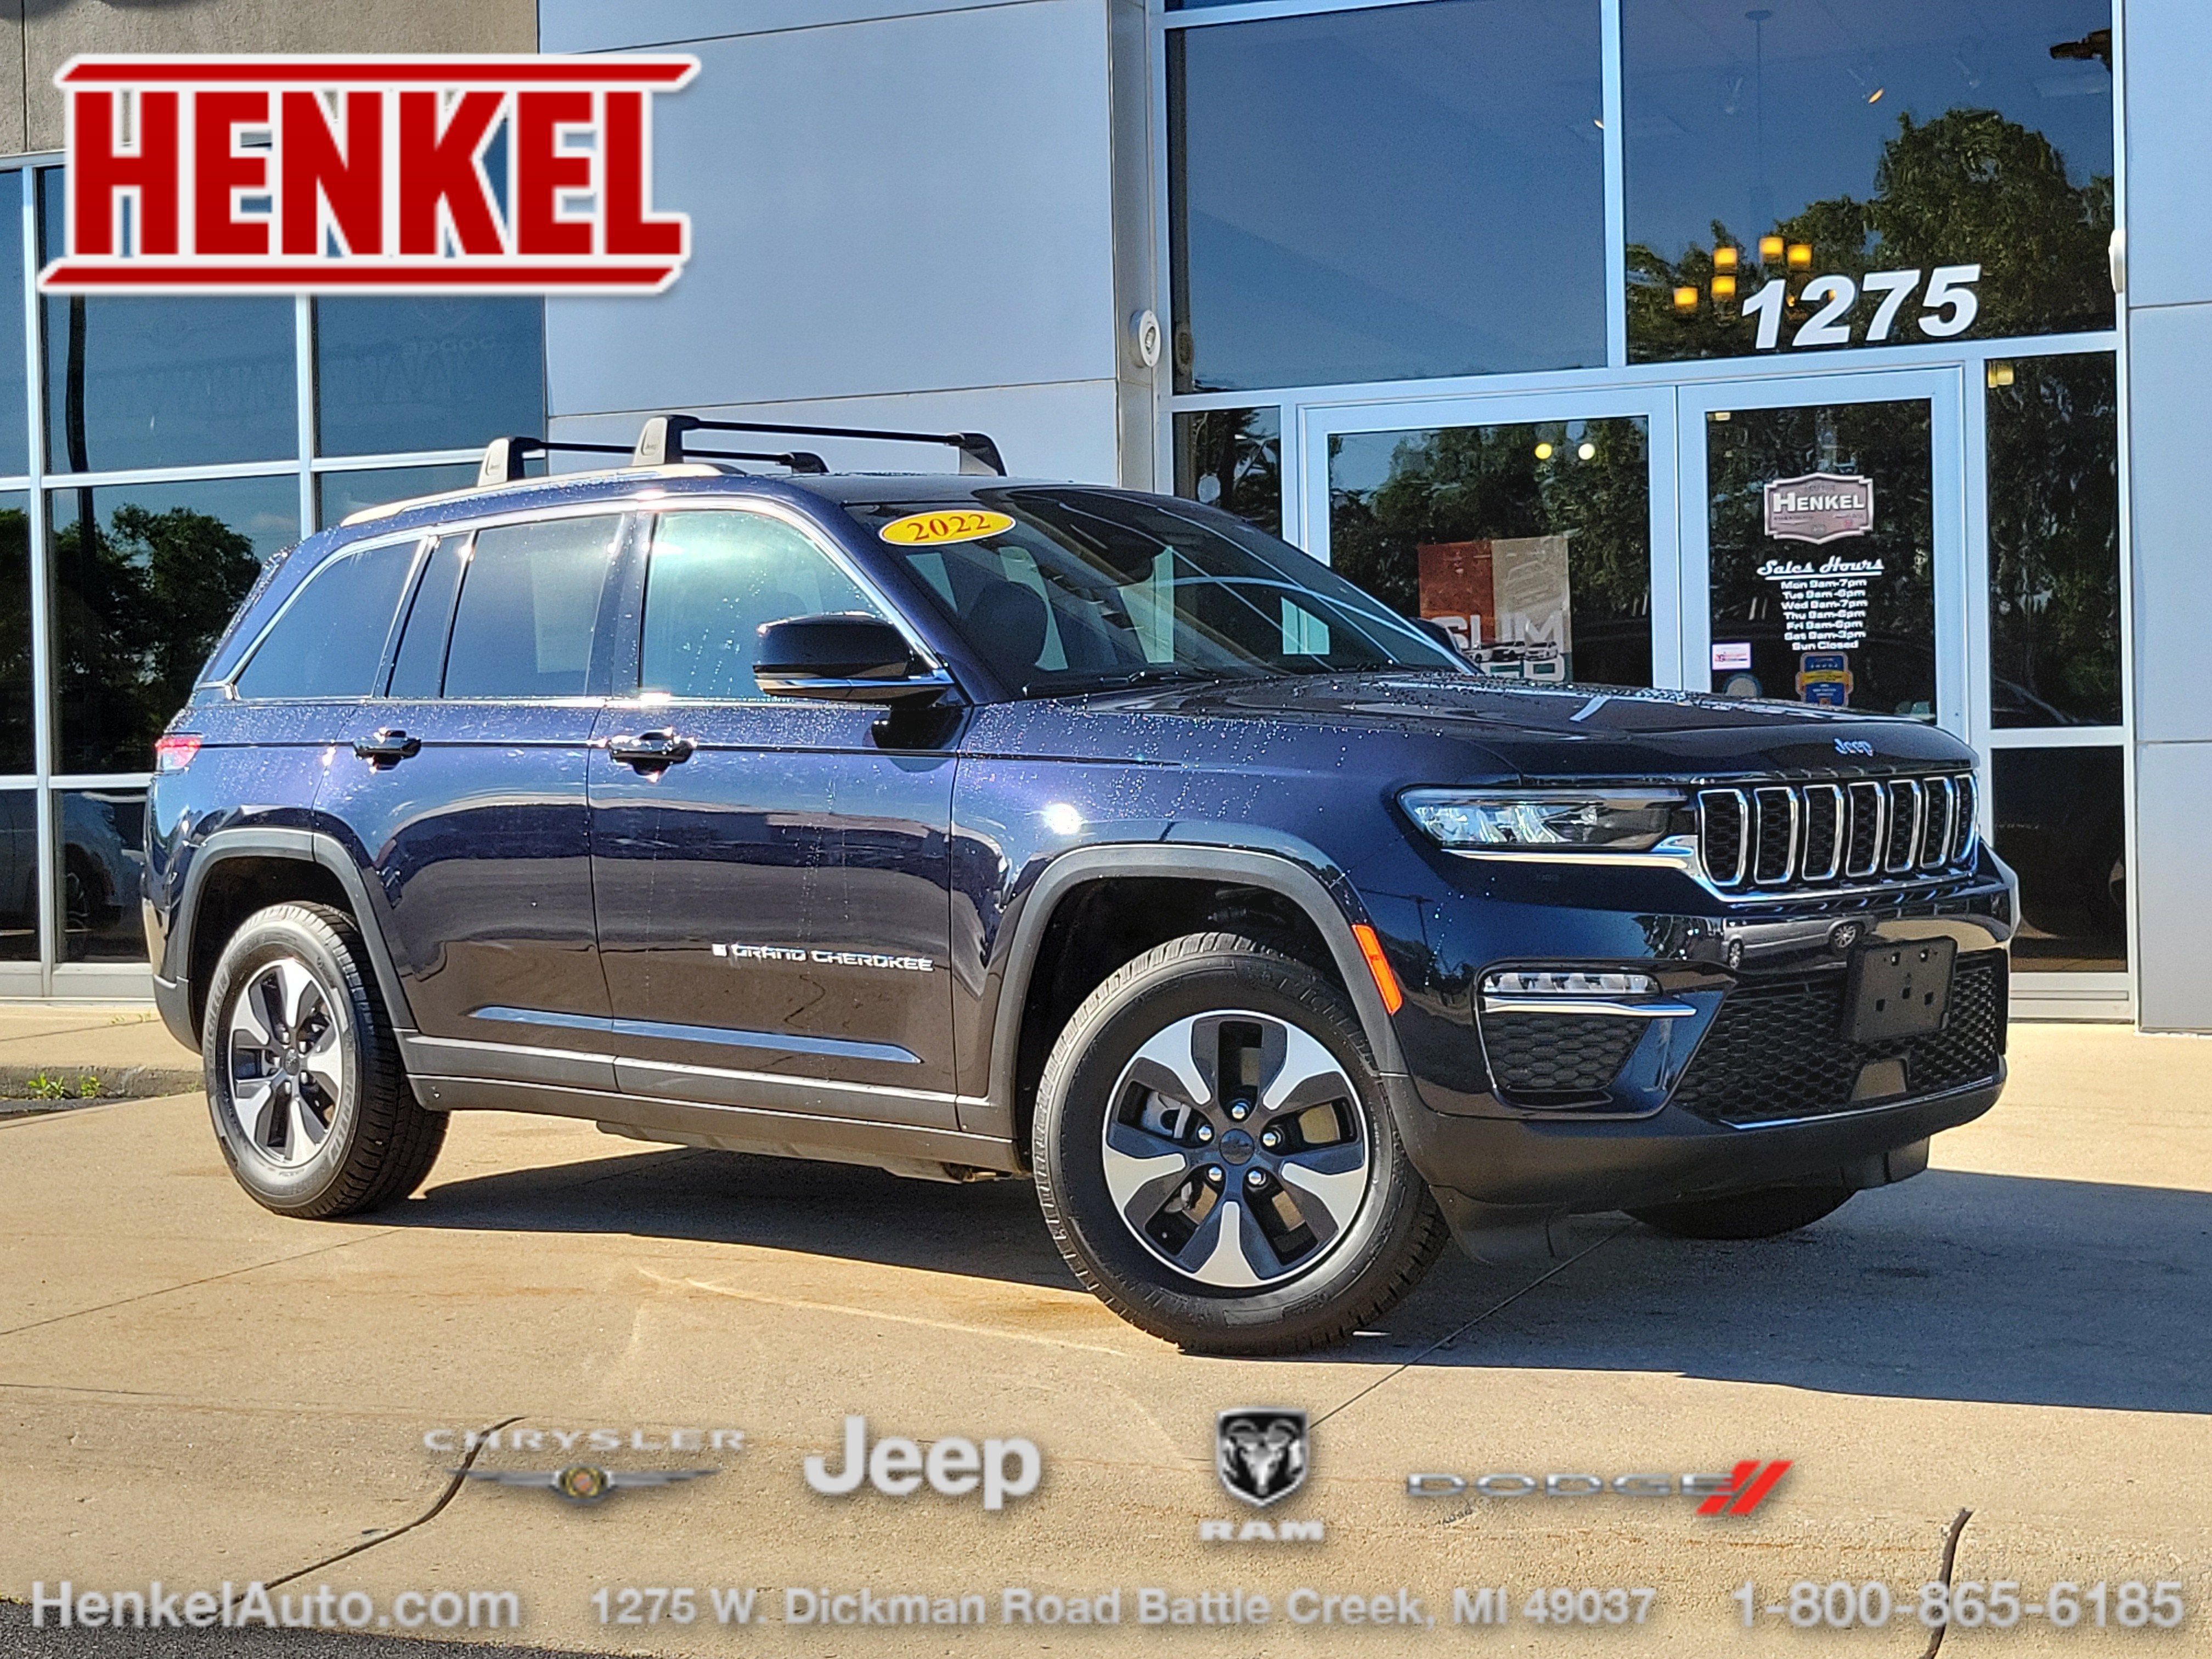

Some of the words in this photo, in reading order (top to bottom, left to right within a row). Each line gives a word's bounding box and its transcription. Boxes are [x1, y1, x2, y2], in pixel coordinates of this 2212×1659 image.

[1742, 264, 1981, 349] 1275
[1773, 492, 1865, 512] HENKEL
[907, 514, 991, 541] 2022
[1757, 560, 1815, 575] Sales
[1819, 555, 1884, 573] Hours
[1781, 580, 1808, 589] Mon
[1782, 590, 1804, 600] Tue
[1781, 601, 1809, 610] Wed
[1783, 611, 1807, 620] Thu
[1786, 622, 1804, 630] Fri
[1784, 631, 1807, 640] Sat
[1792, 642, 1816, 651] Sun
[1817, 640, 1859, 650] Closed
[1833, 738, 1874, 757] Jeep
[731, 942, 806, 961] GRAND
[810, 949, 934, 972] CHEROKEE
